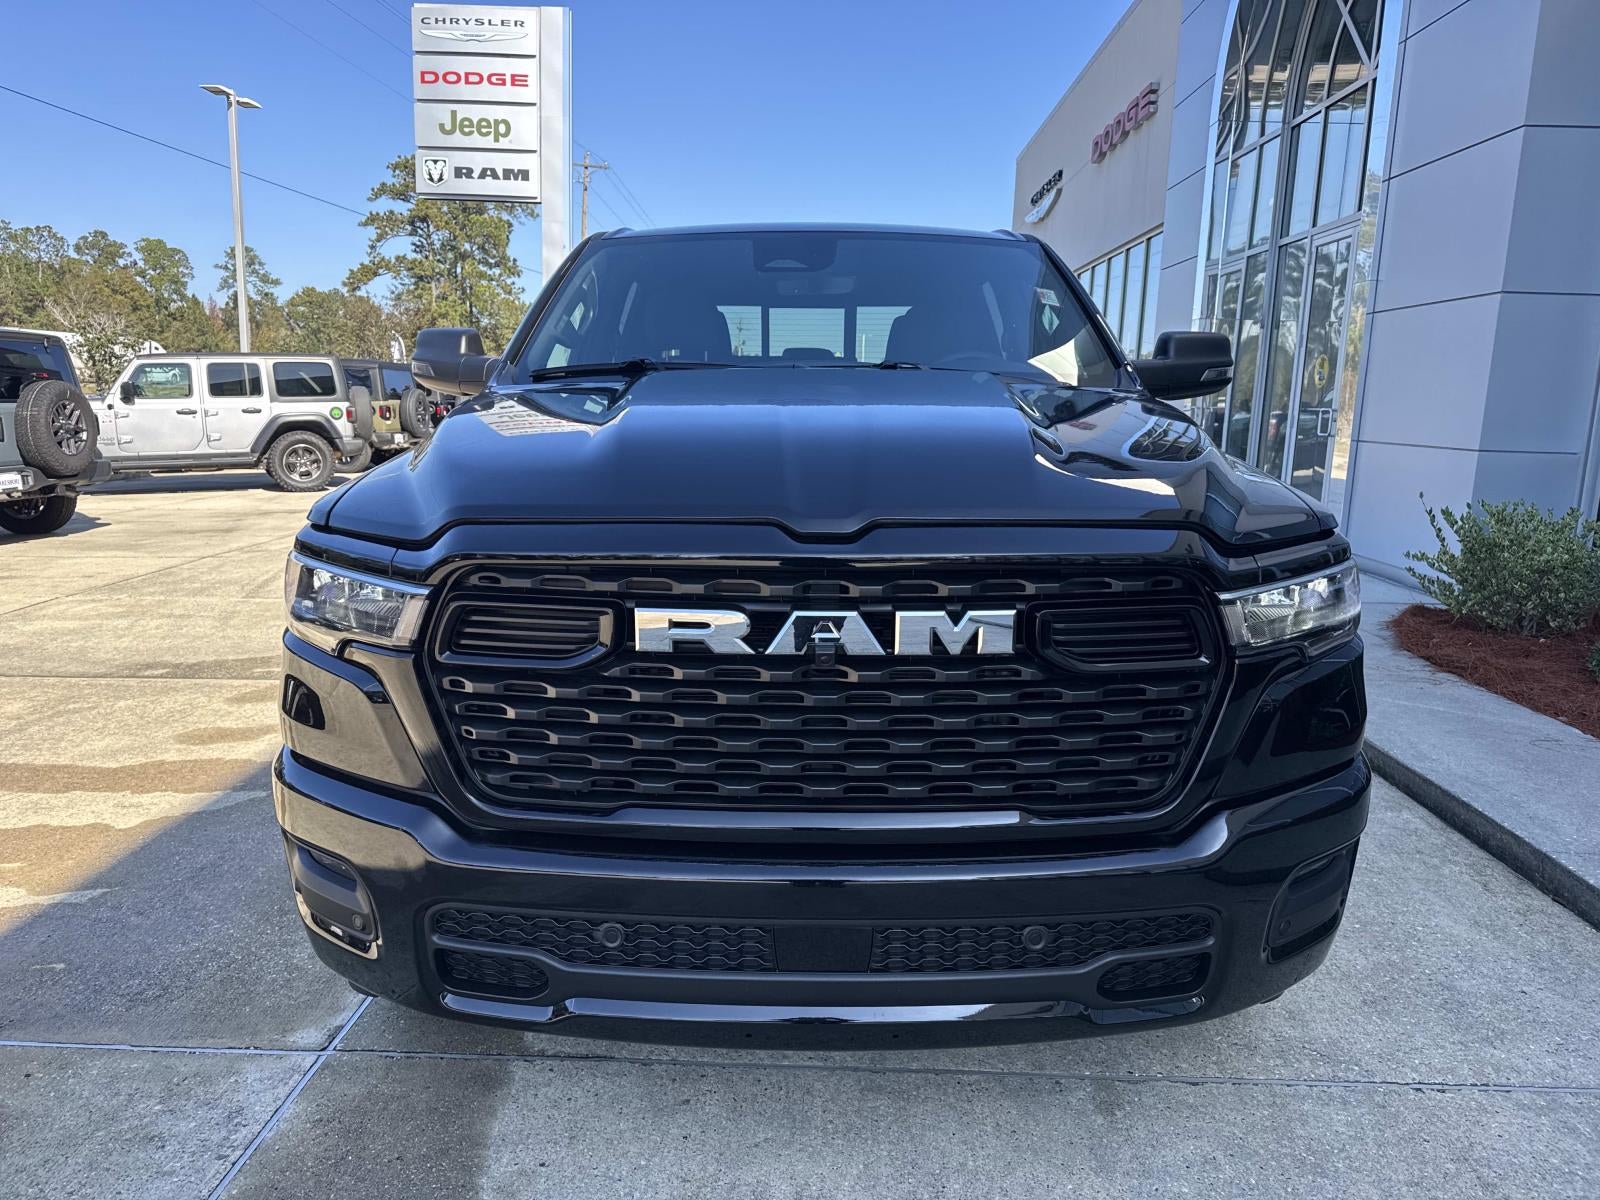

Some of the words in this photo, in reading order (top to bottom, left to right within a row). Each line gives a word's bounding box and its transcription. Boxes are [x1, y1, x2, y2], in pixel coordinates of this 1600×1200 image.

[420, 16, 525, 28] CHRYSLER
[420, 70, 529, 87] DODGE
[438, 110, 512, 143] Jeep
[1090, 81, 1160, 164] DODGE
[453, 166, 530, 182] RAM
[634, 607, 1018, 655] RAM
